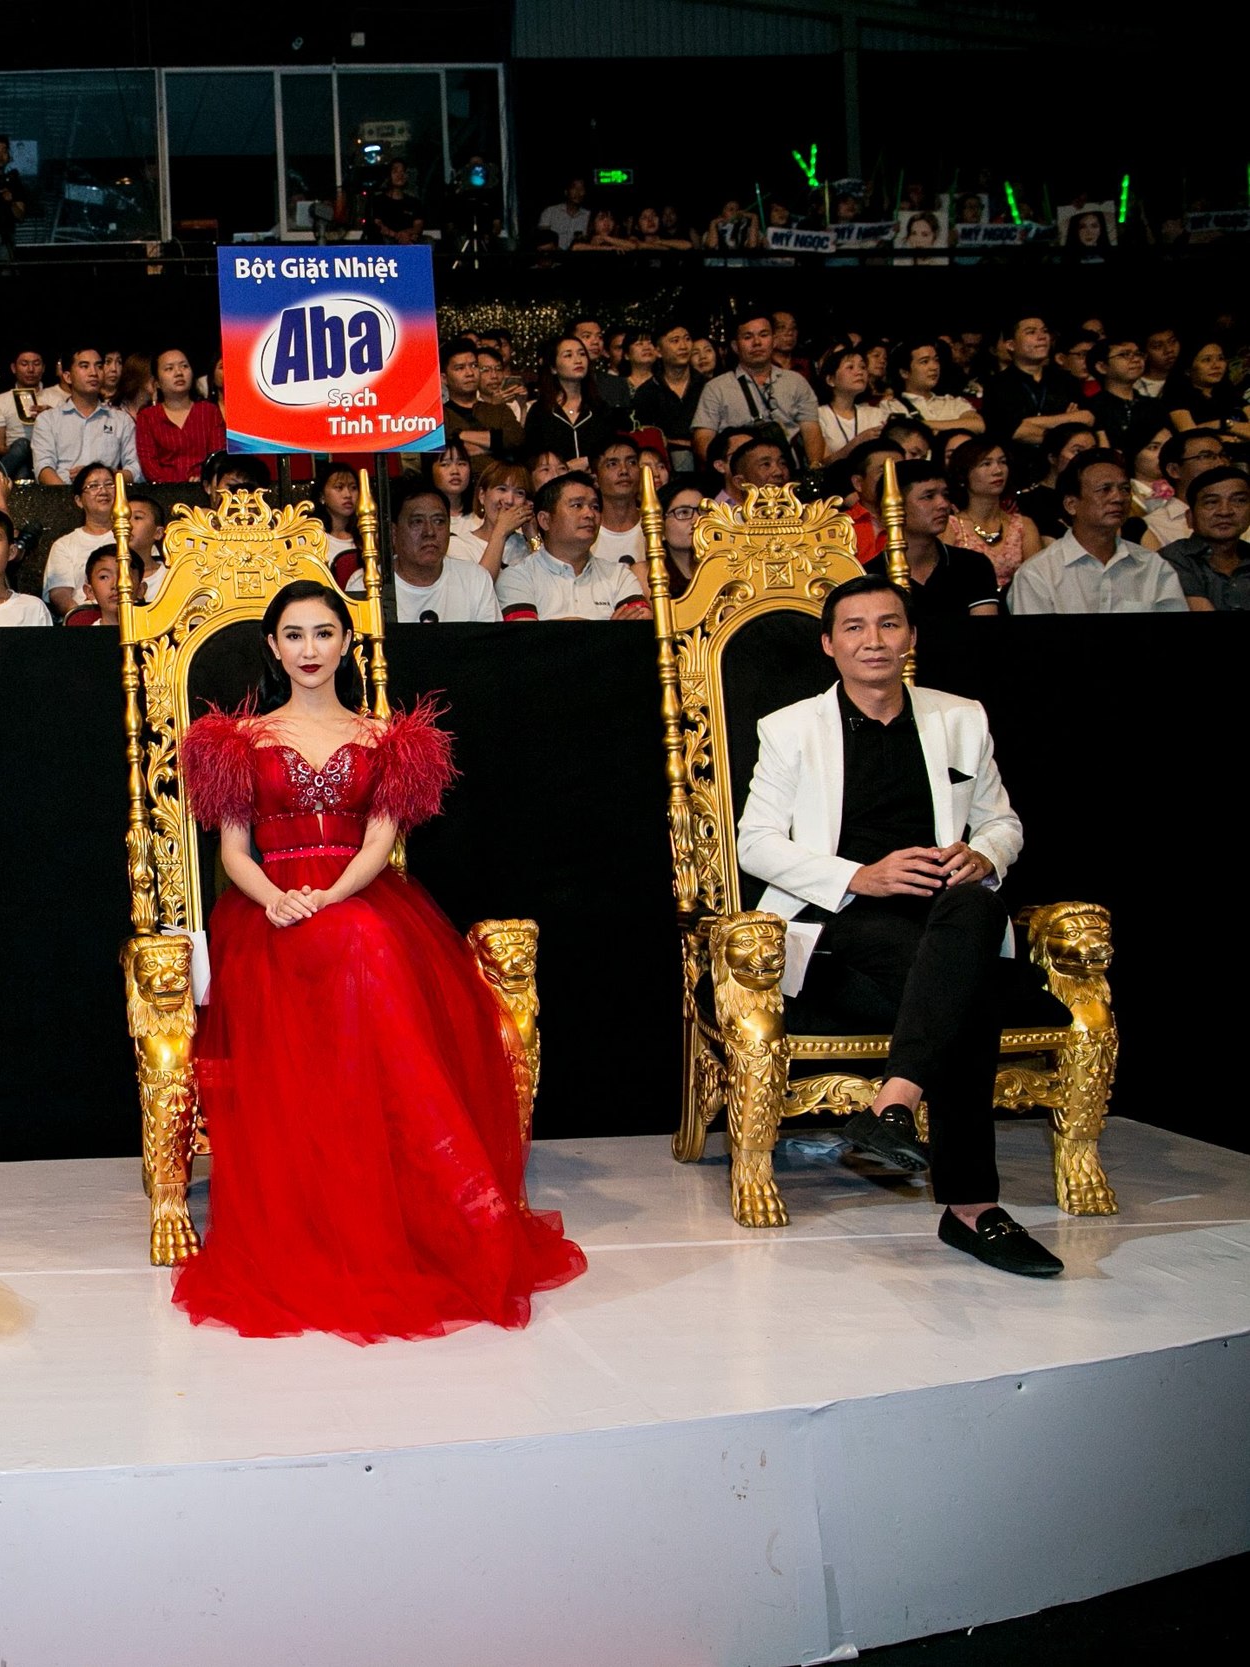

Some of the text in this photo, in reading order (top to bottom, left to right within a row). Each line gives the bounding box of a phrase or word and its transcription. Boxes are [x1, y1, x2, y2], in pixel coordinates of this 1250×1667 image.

[235, 256, 399, 284] Bột Giặt Nhiệt
[271, 305, 384, 386] Aba
[327, 387, 378, 412] Sạch
[327, 414, 437, 435] Tinh Tươm
